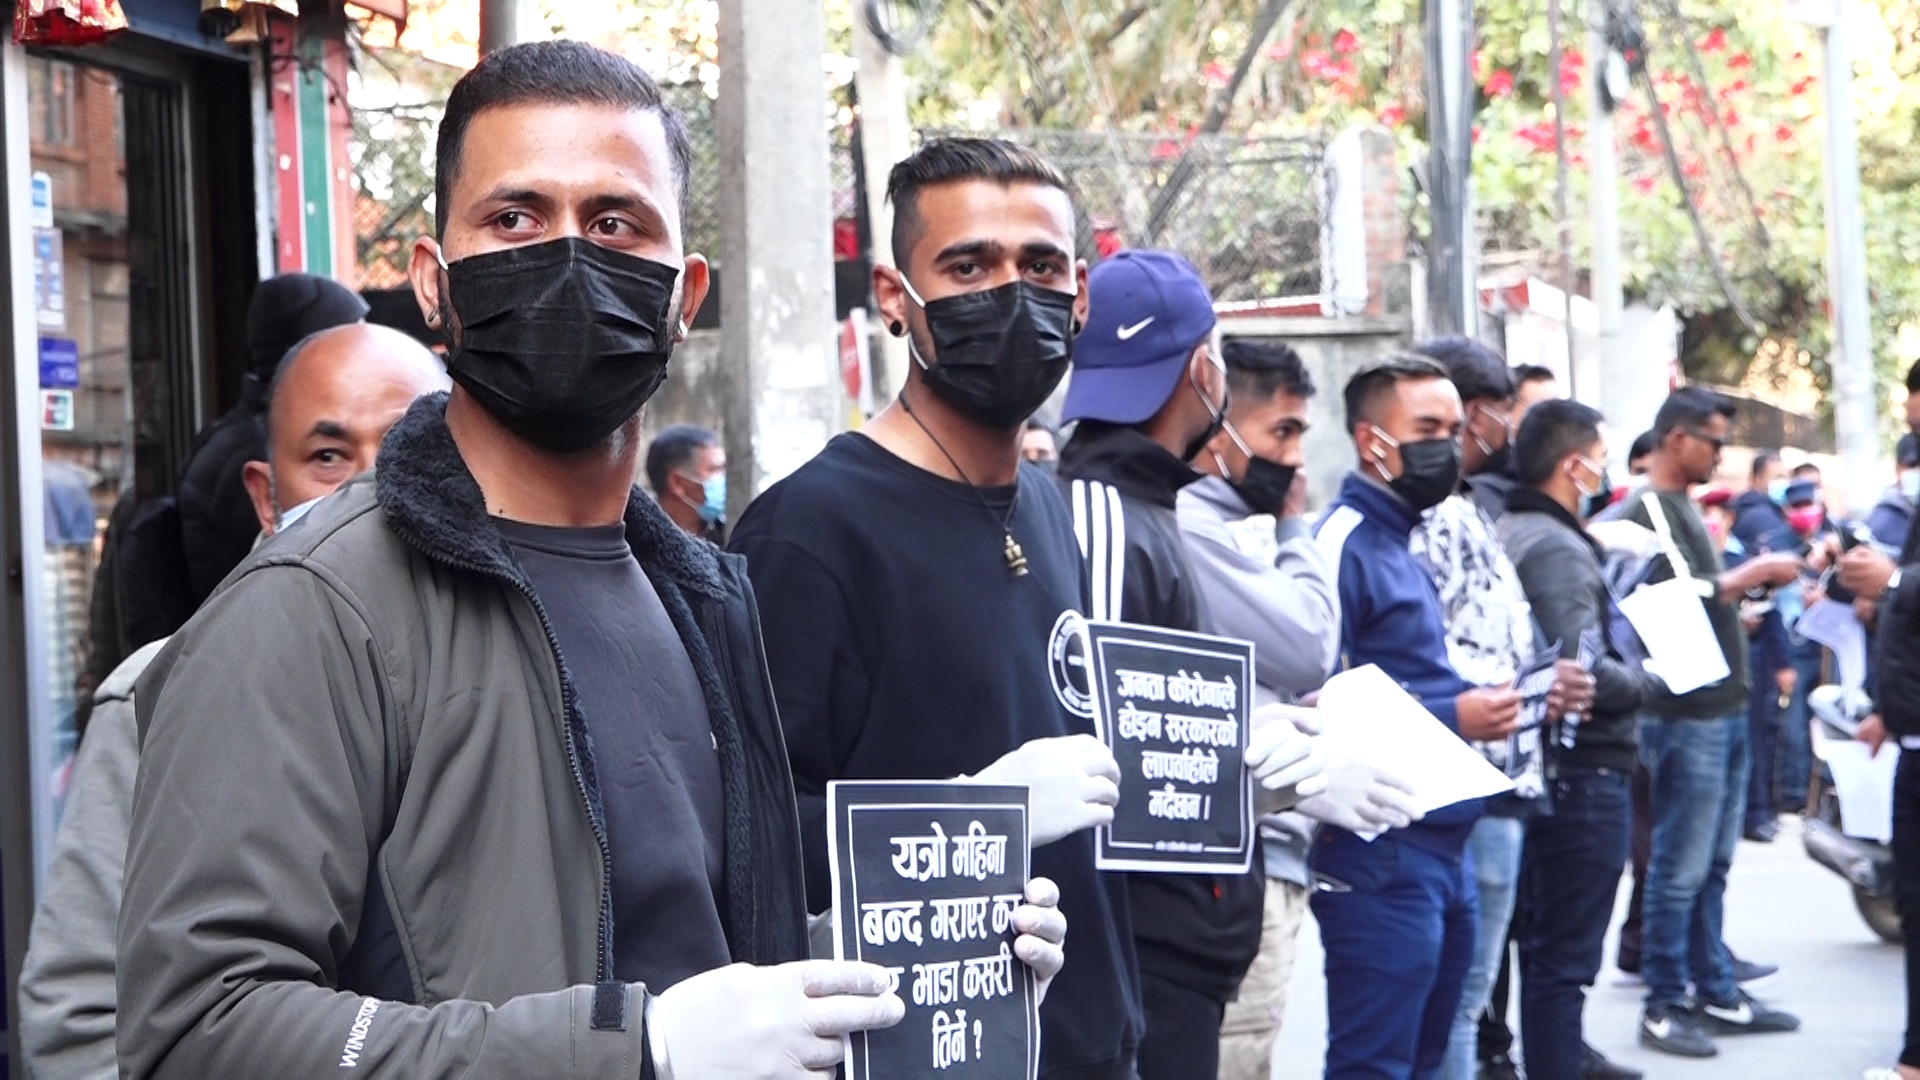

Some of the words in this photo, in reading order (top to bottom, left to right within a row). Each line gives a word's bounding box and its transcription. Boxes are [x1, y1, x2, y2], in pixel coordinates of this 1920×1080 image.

[1115, 669, 1165, 701] जनता
[1167, 669, 1237, 710] कोरोनाले
[1118, 700, 1162, 742] होइन
[1164, 713, 1238, 748] सरकारको
[889, 821, 948, 882] यत्रो
[951, 819, 1008, 882] महिना
[861, 900, 924, 946] बन्द
[929, 896, 990, 942] गराएर
[912, 961, 961, 1006] भाडा
[963, 941, 1014, 1000] कसरी
